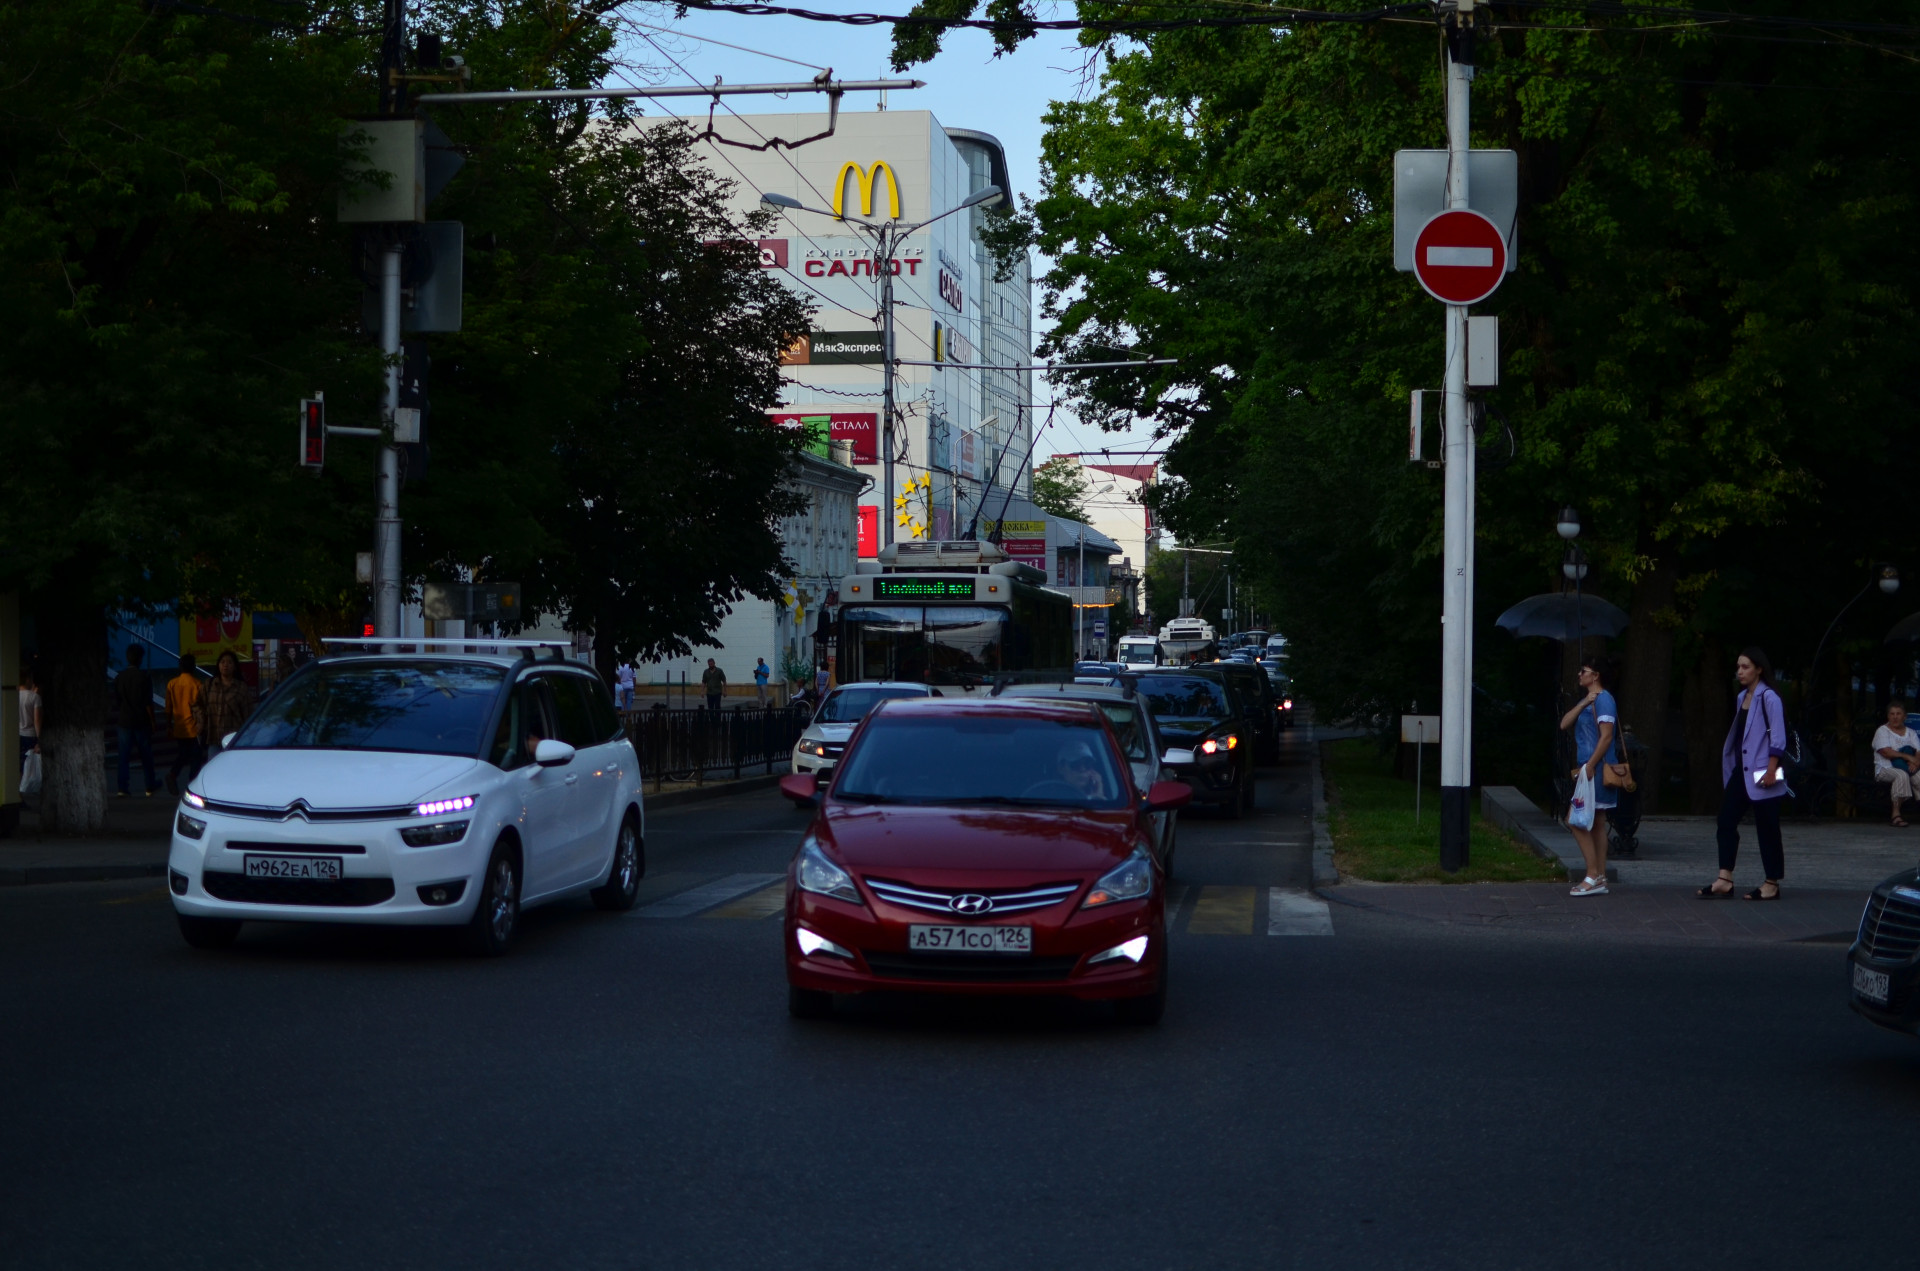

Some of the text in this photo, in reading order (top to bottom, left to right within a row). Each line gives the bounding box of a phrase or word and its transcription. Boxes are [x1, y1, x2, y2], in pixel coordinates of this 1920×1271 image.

[804, 258, 922, 278] САЛЮТ
[813, 342, 885, 354] МакЭкспрес
[830, 421, 870, 431] ИСТАЛЛ
[249, 860, 336, 877] М962ЕА 126
[916, 927, 1025, 948] А571СО 126
